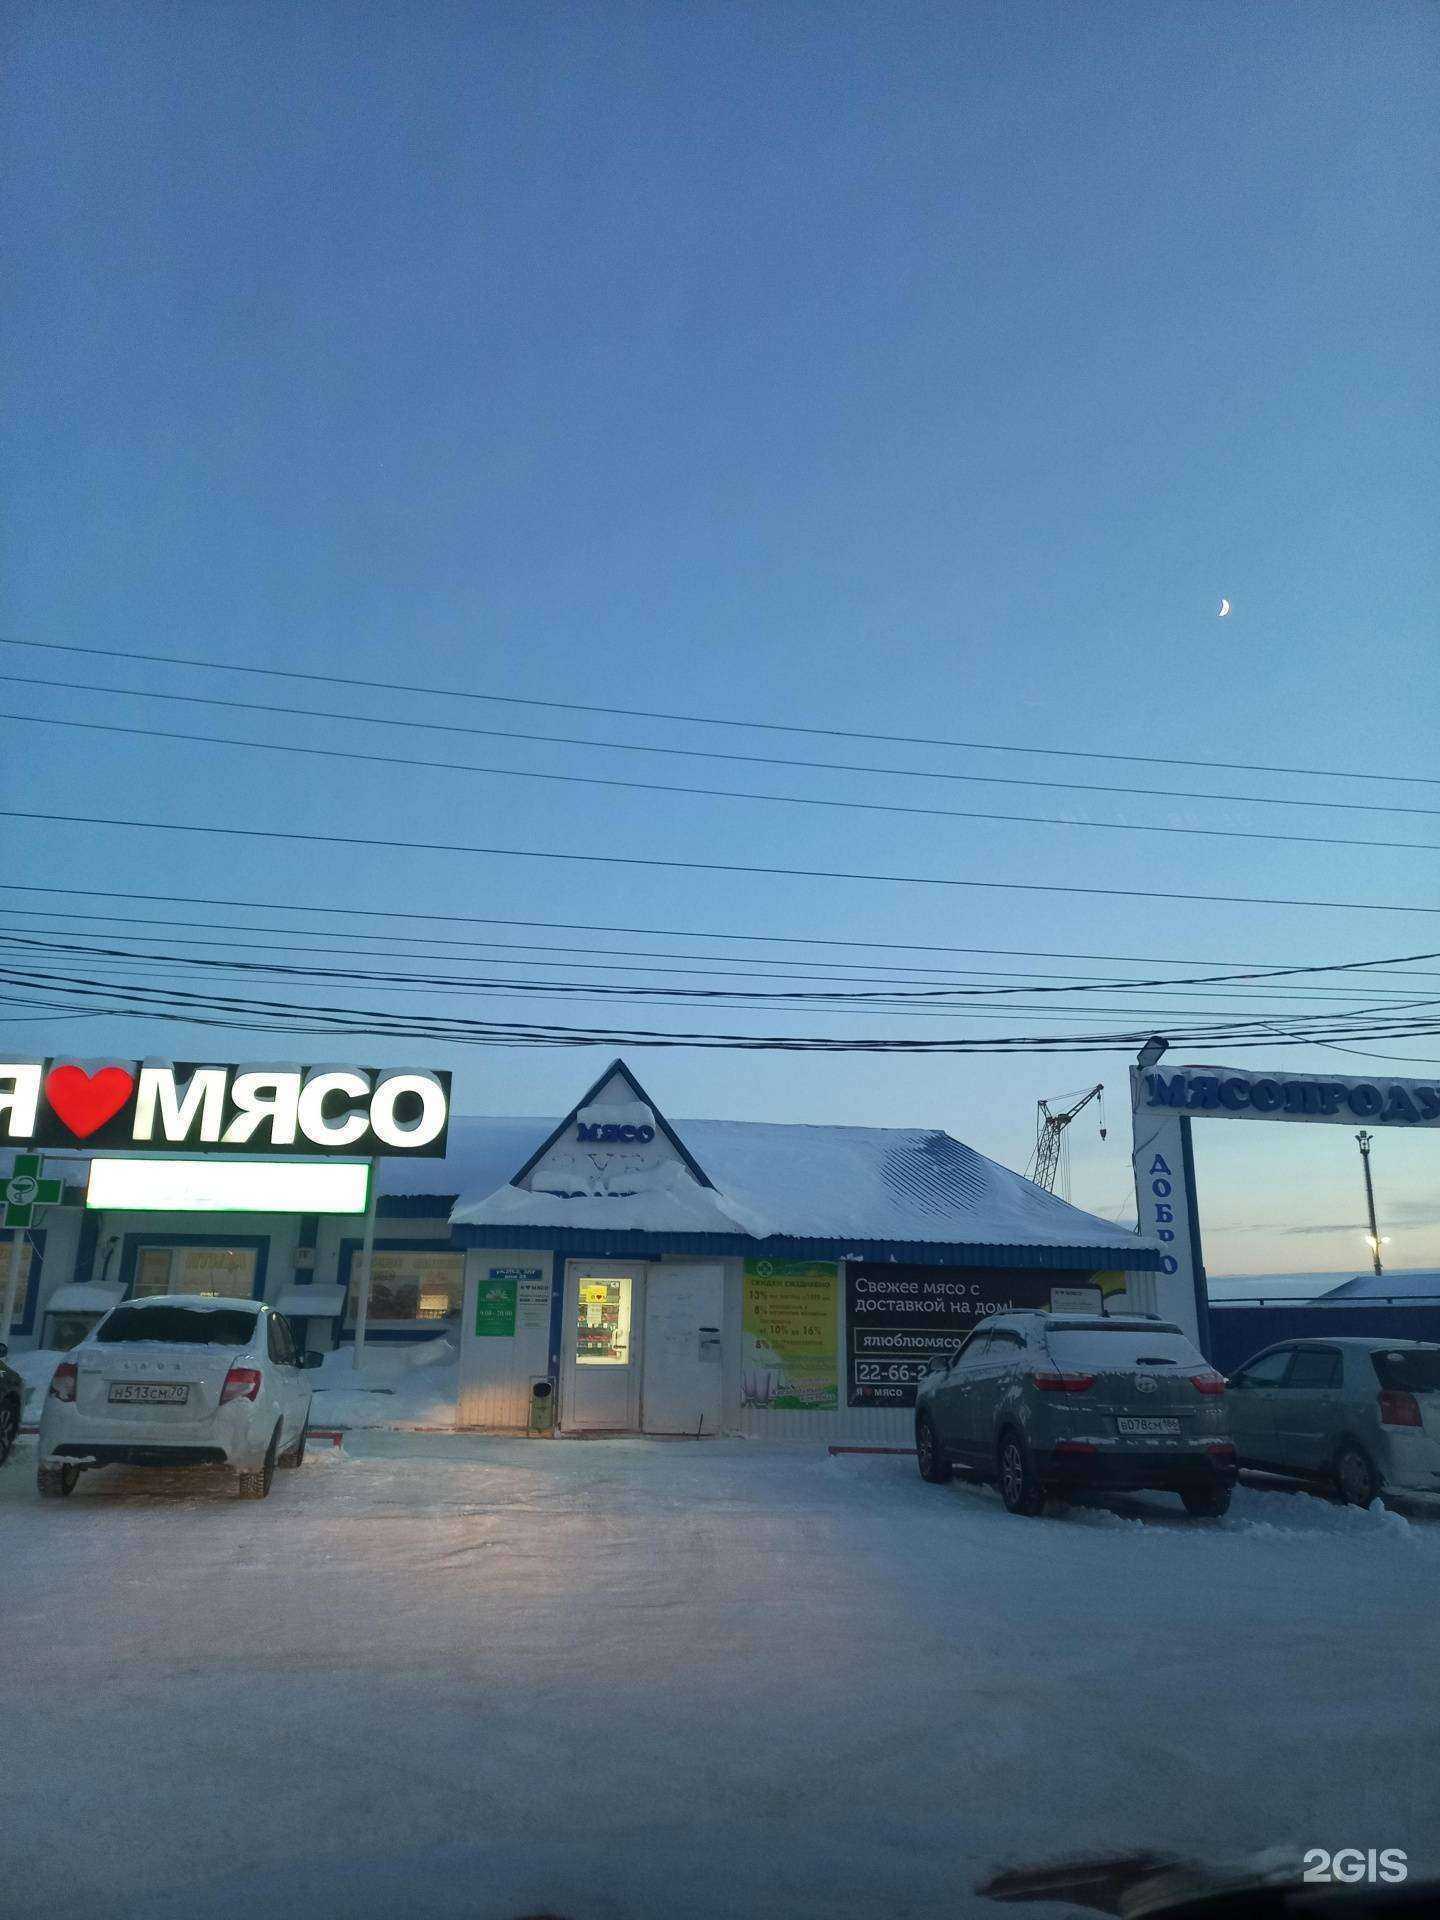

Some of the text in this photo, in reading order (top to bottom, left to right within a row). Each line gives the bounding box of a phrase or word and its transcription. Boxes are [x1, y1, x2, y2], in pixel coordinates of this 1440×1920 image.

[132, 1066, 448, 1148] МЯСО
[576, 1122, 656, 1144] МЯСО
[855, 1278, 981, 1296] Свежее мясо с
[855, 1297, 946, 1313] доставкой
[950, 1301, 971, 1314] на
[863, 1333, 962, 1350] ялюблюмясо
